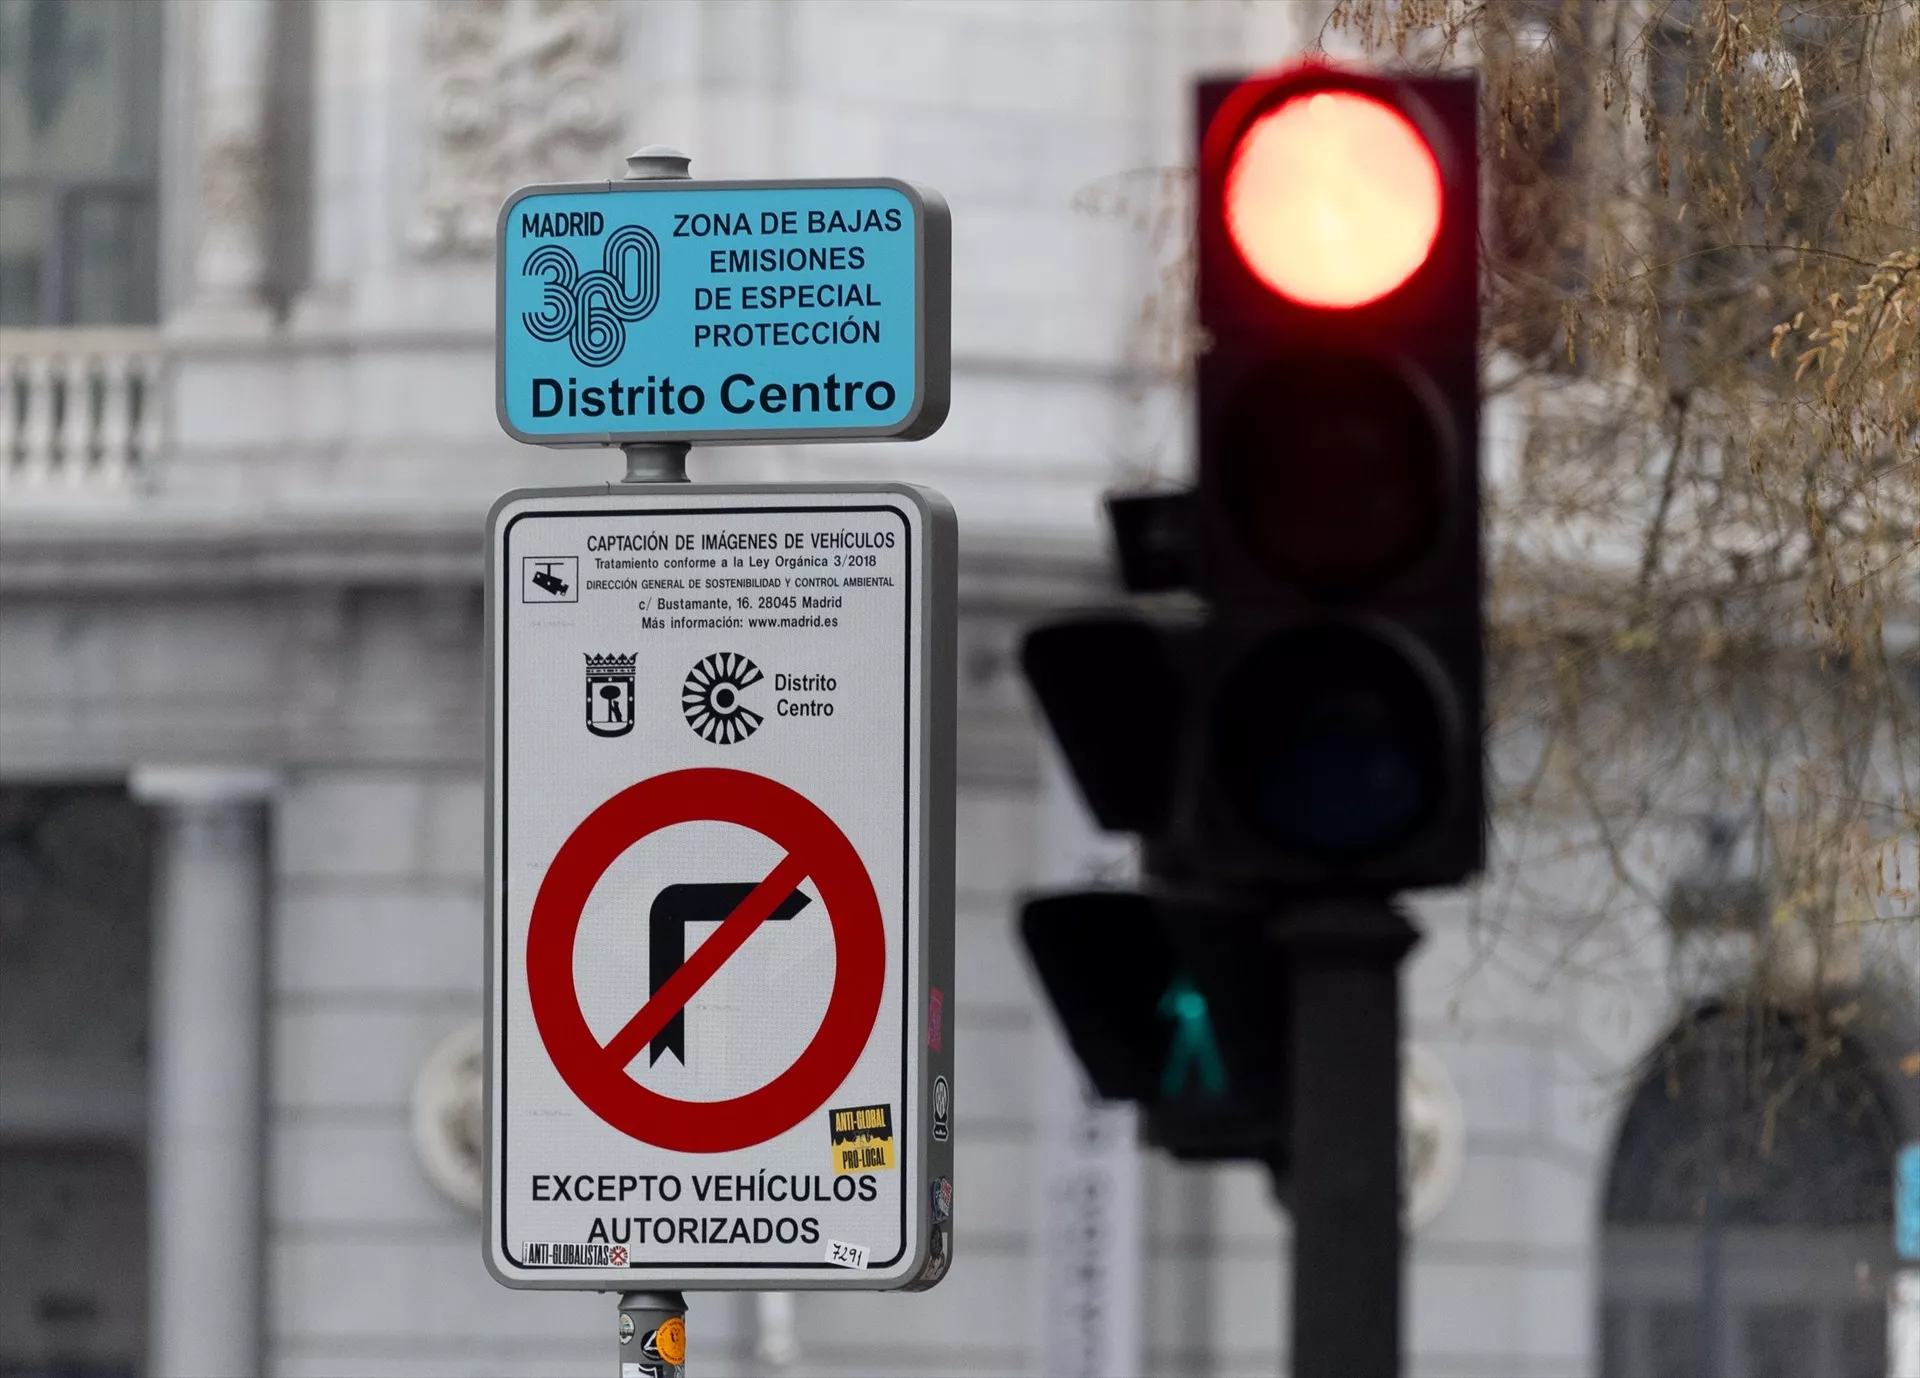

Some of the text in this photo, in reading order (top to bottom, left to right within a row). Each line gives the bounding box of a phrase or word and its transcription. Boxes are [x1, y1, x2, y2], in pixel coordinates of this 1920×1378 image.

[523, 212, 604, 238] MADRID
[673, 209, 901, 237] ZONA DE BAJAS
[711, 247, 864, 273] EMISIONES
[522, 225, 660, 368] 360
[695, 284, 881, 310] DE ESPECIAL
[695, 315, 879, 347] PROTECCIÓN
[533, 374, 895, 417] Distrito Centro
[587, 529, 894, 551] CAPTACIÓN DE IMÁGENES DE VEHÍCULOS
[595, 555, 876, 569] Tratamiento conforme a la Ley Orgánica 3/2018
[587, 577, 894, 590] DIRECCIÓN GENERAL DE SOSTENIBILIDAD Y CONTROL AMBIENTAL
[639, 596, 841, 610] c/ Bustamante, 16. 28045 Madrid
[642, 616, 838, 629] Más información: www.madrid.es
[775, 674, 836, 691] Distrito
[777, 699, 833, 716] Centro
[836, 1108, 886, 1132] ANTI-GLOBAL
[842, 1147, 886, 1170] PRO-LOCAL
[533, 1169, 877, 1201] EXCEPTO VEHÍCULOS
[587, 1218, 819, 1244] AUTORIZADOS
[528, 1243, 609, 1266] ANTI-GLOBALISTAS
[833, 1243, 862, 1267] 7291
